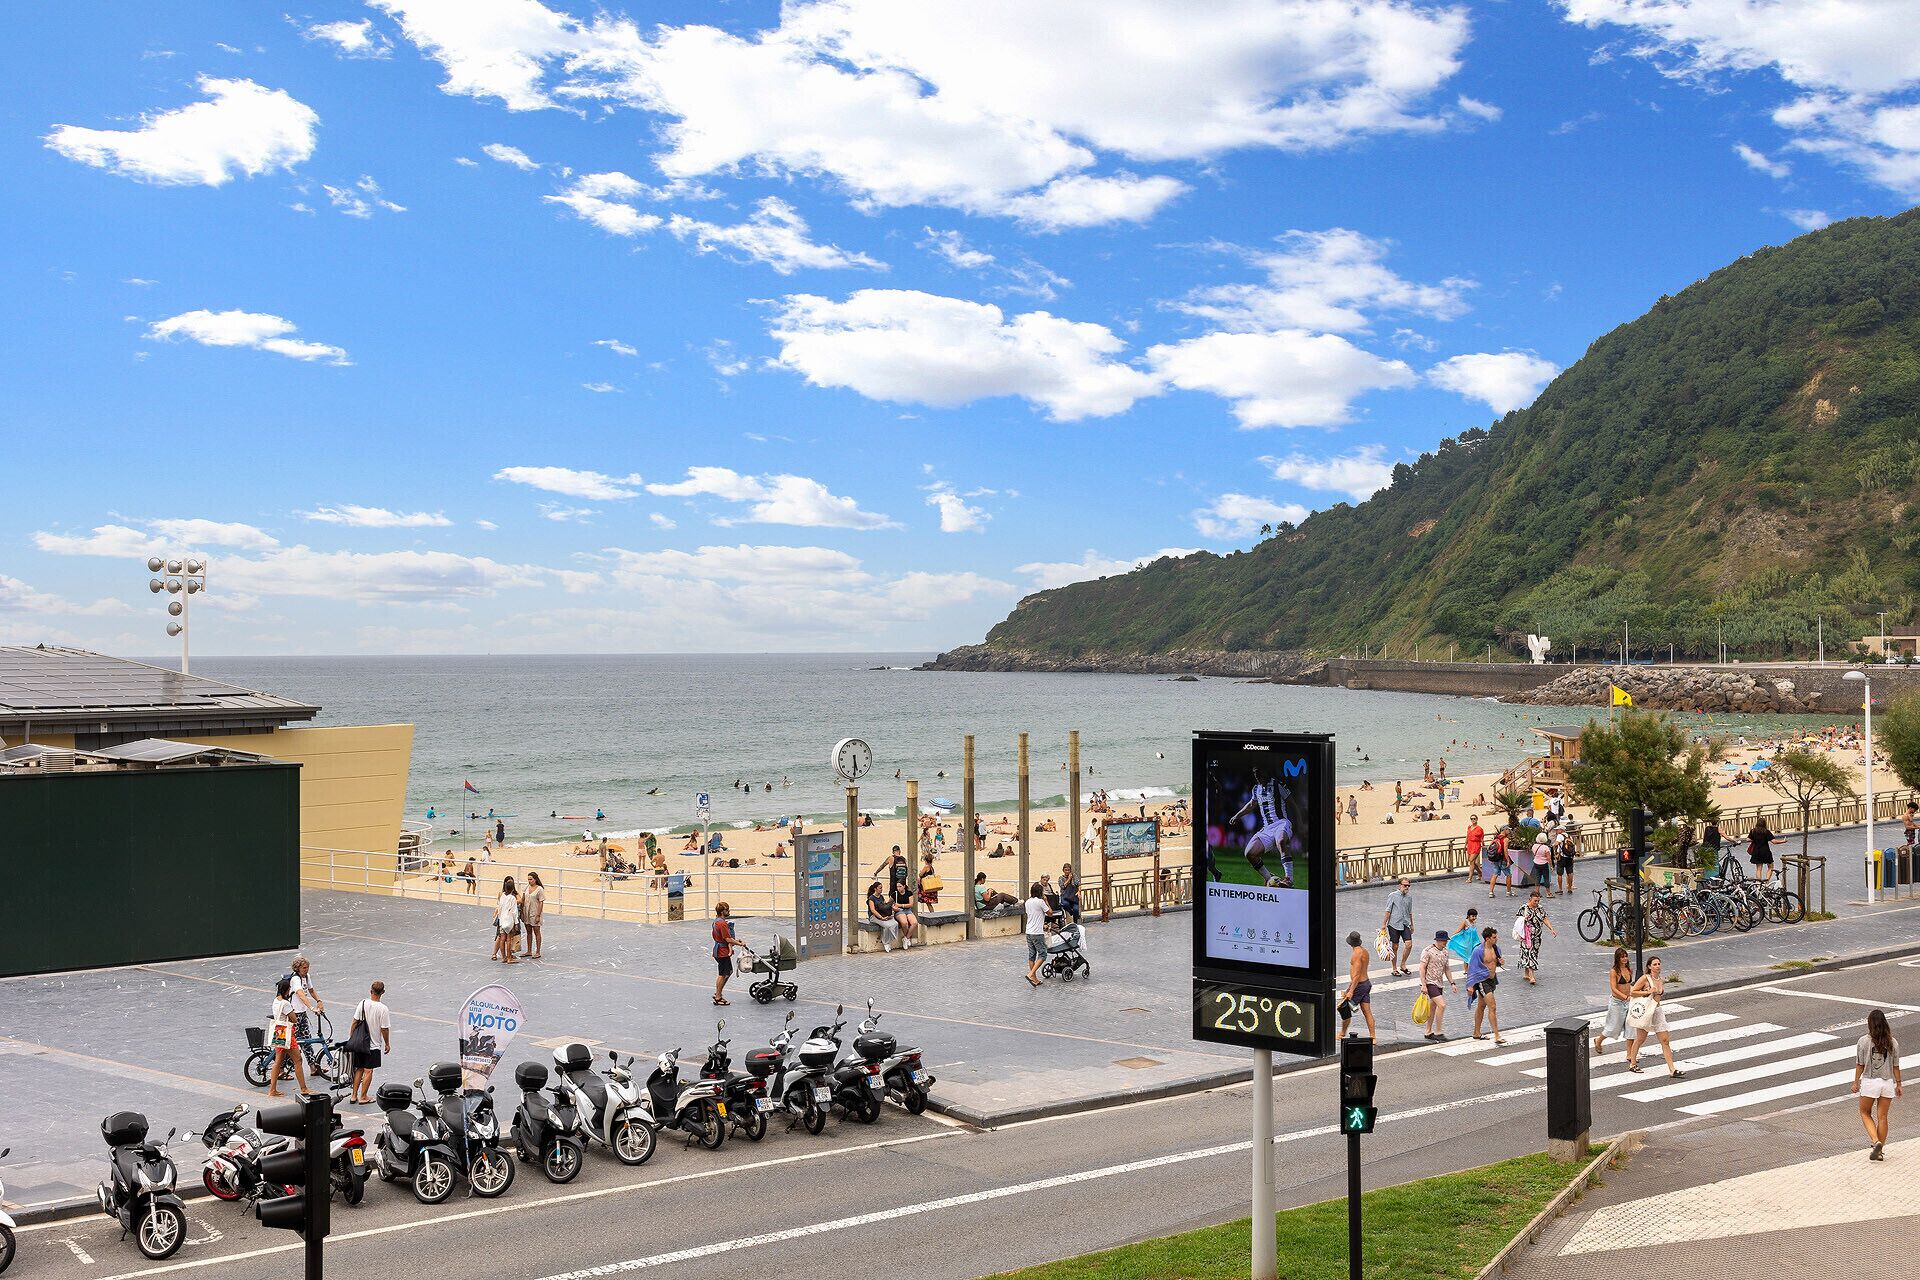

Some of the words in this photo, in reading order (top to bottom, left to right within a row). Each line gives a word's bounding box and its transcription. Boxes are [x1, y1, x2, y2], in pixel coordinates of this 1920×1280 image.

[1242, 743, 1270, 751] JCDecaux
[1208, 888, 1220, 897] EN
[1222, 889, 1255, 900] TIEMPO
[1256, 893, 1280, 903] REAL
[469, 1000, 500, 1010] ALQUILA
[500, 1006, 519, 1014] RENT
[468, 1012, 517, 1031] MOTO
[1214, 992, 1302, 1038] 25°C
